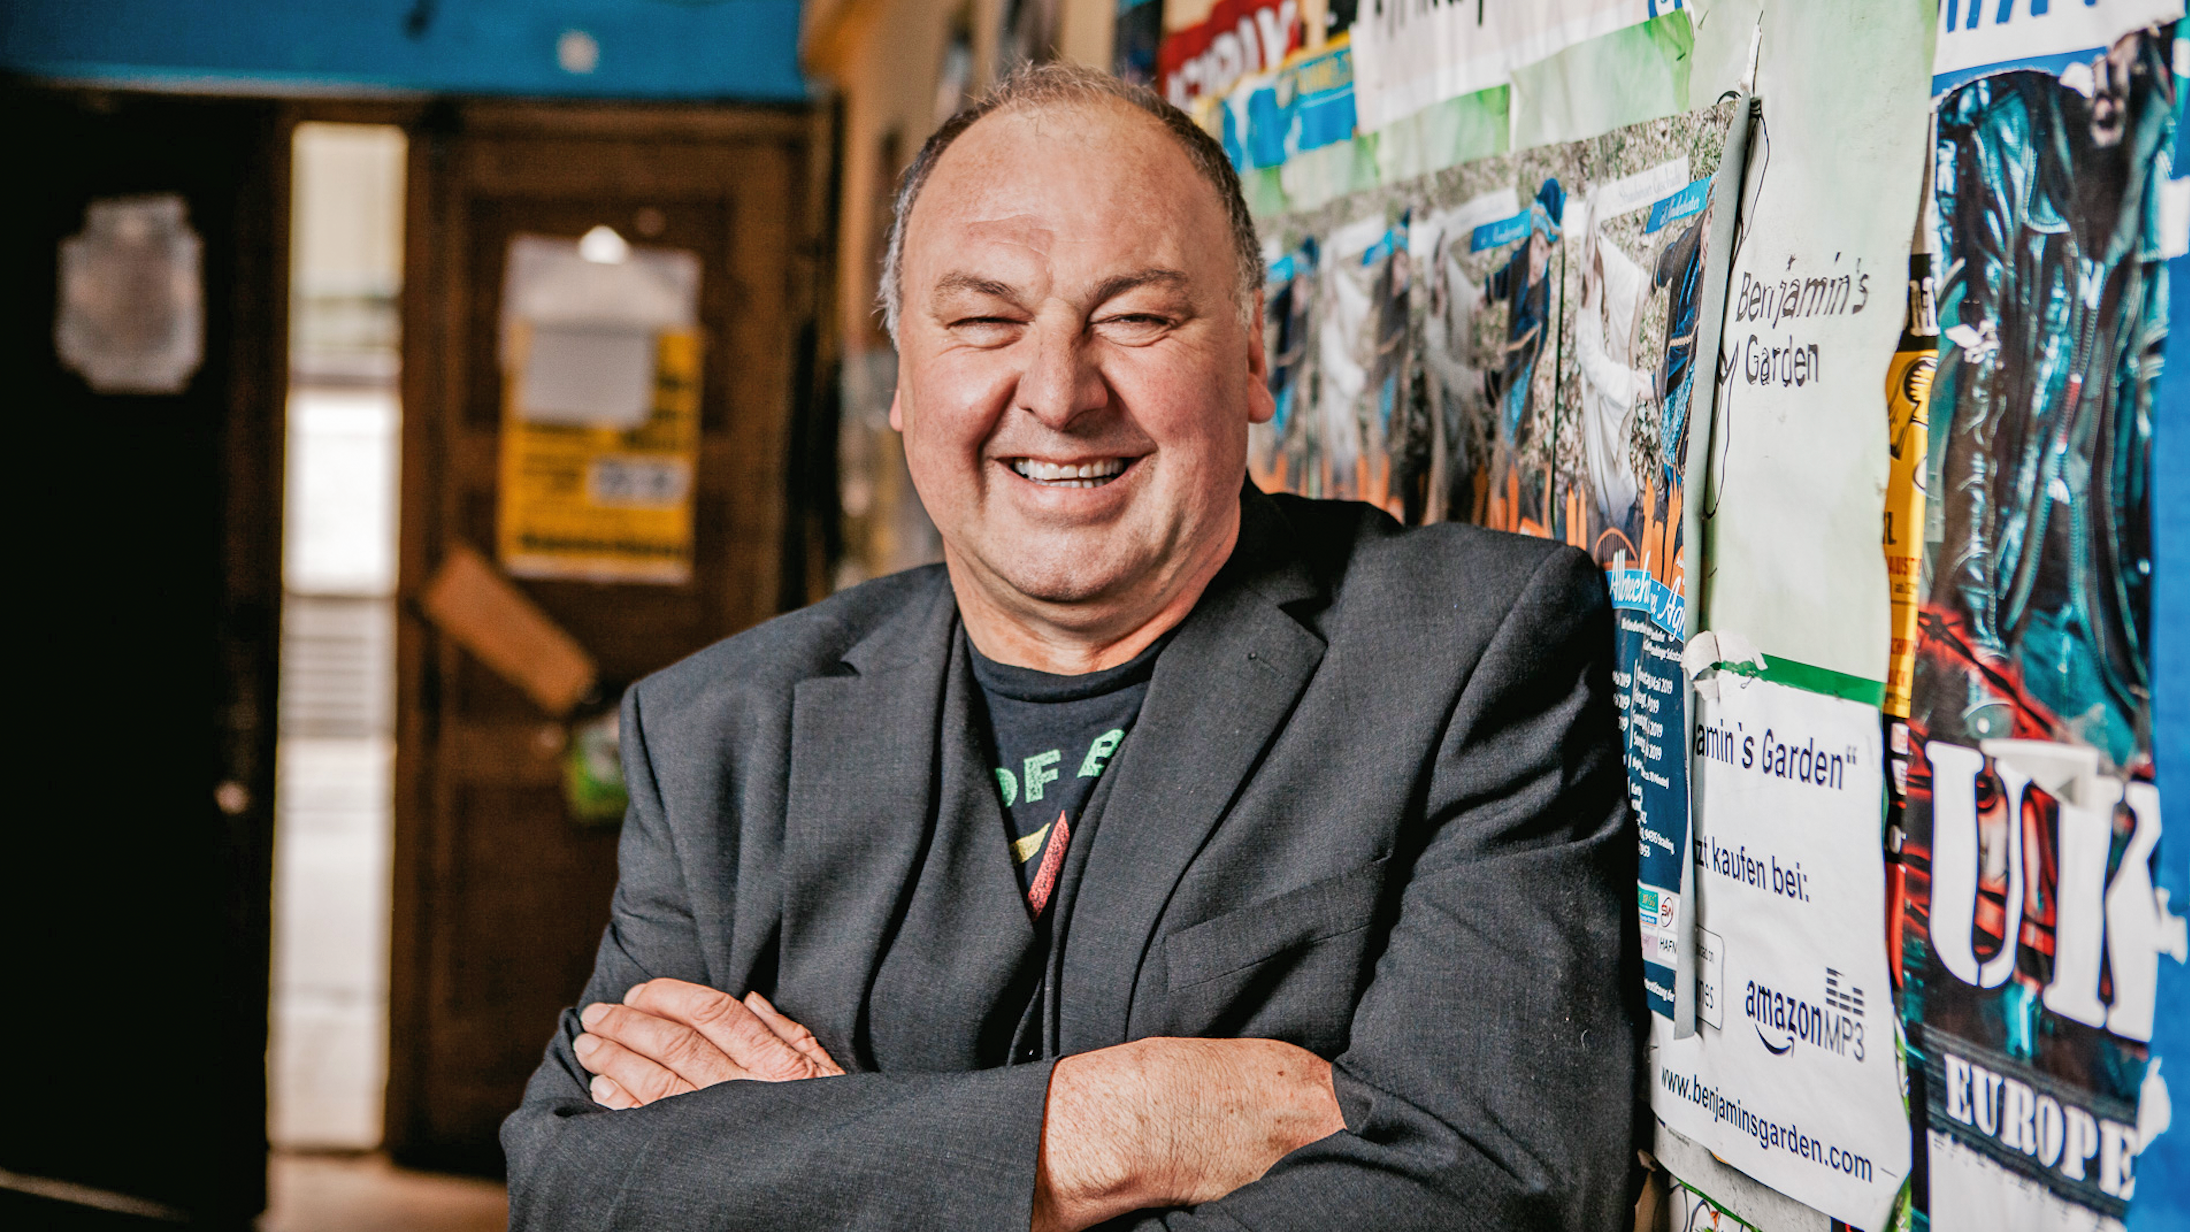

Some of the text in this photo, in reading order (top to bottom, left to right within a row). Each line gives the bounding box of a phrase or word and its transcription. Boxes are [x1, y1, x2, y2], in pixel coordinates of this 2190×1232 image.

[1735, 251, 1869, 330] Benjamin's
[1745, 334, 1819, 388] Garden
[1696, 719, 1755, 769] amin`s
[1693, 835, 1810, 902] zt kaufen bei:
[1925, 739, 2163, 1043] UK
[1745, 980, 1865, 1062] amazonMP3
[1661, 1065, 1873, 1183] www.benjaminsgarden.com
[1944, 1053, 2140, 1201] EUROPE
